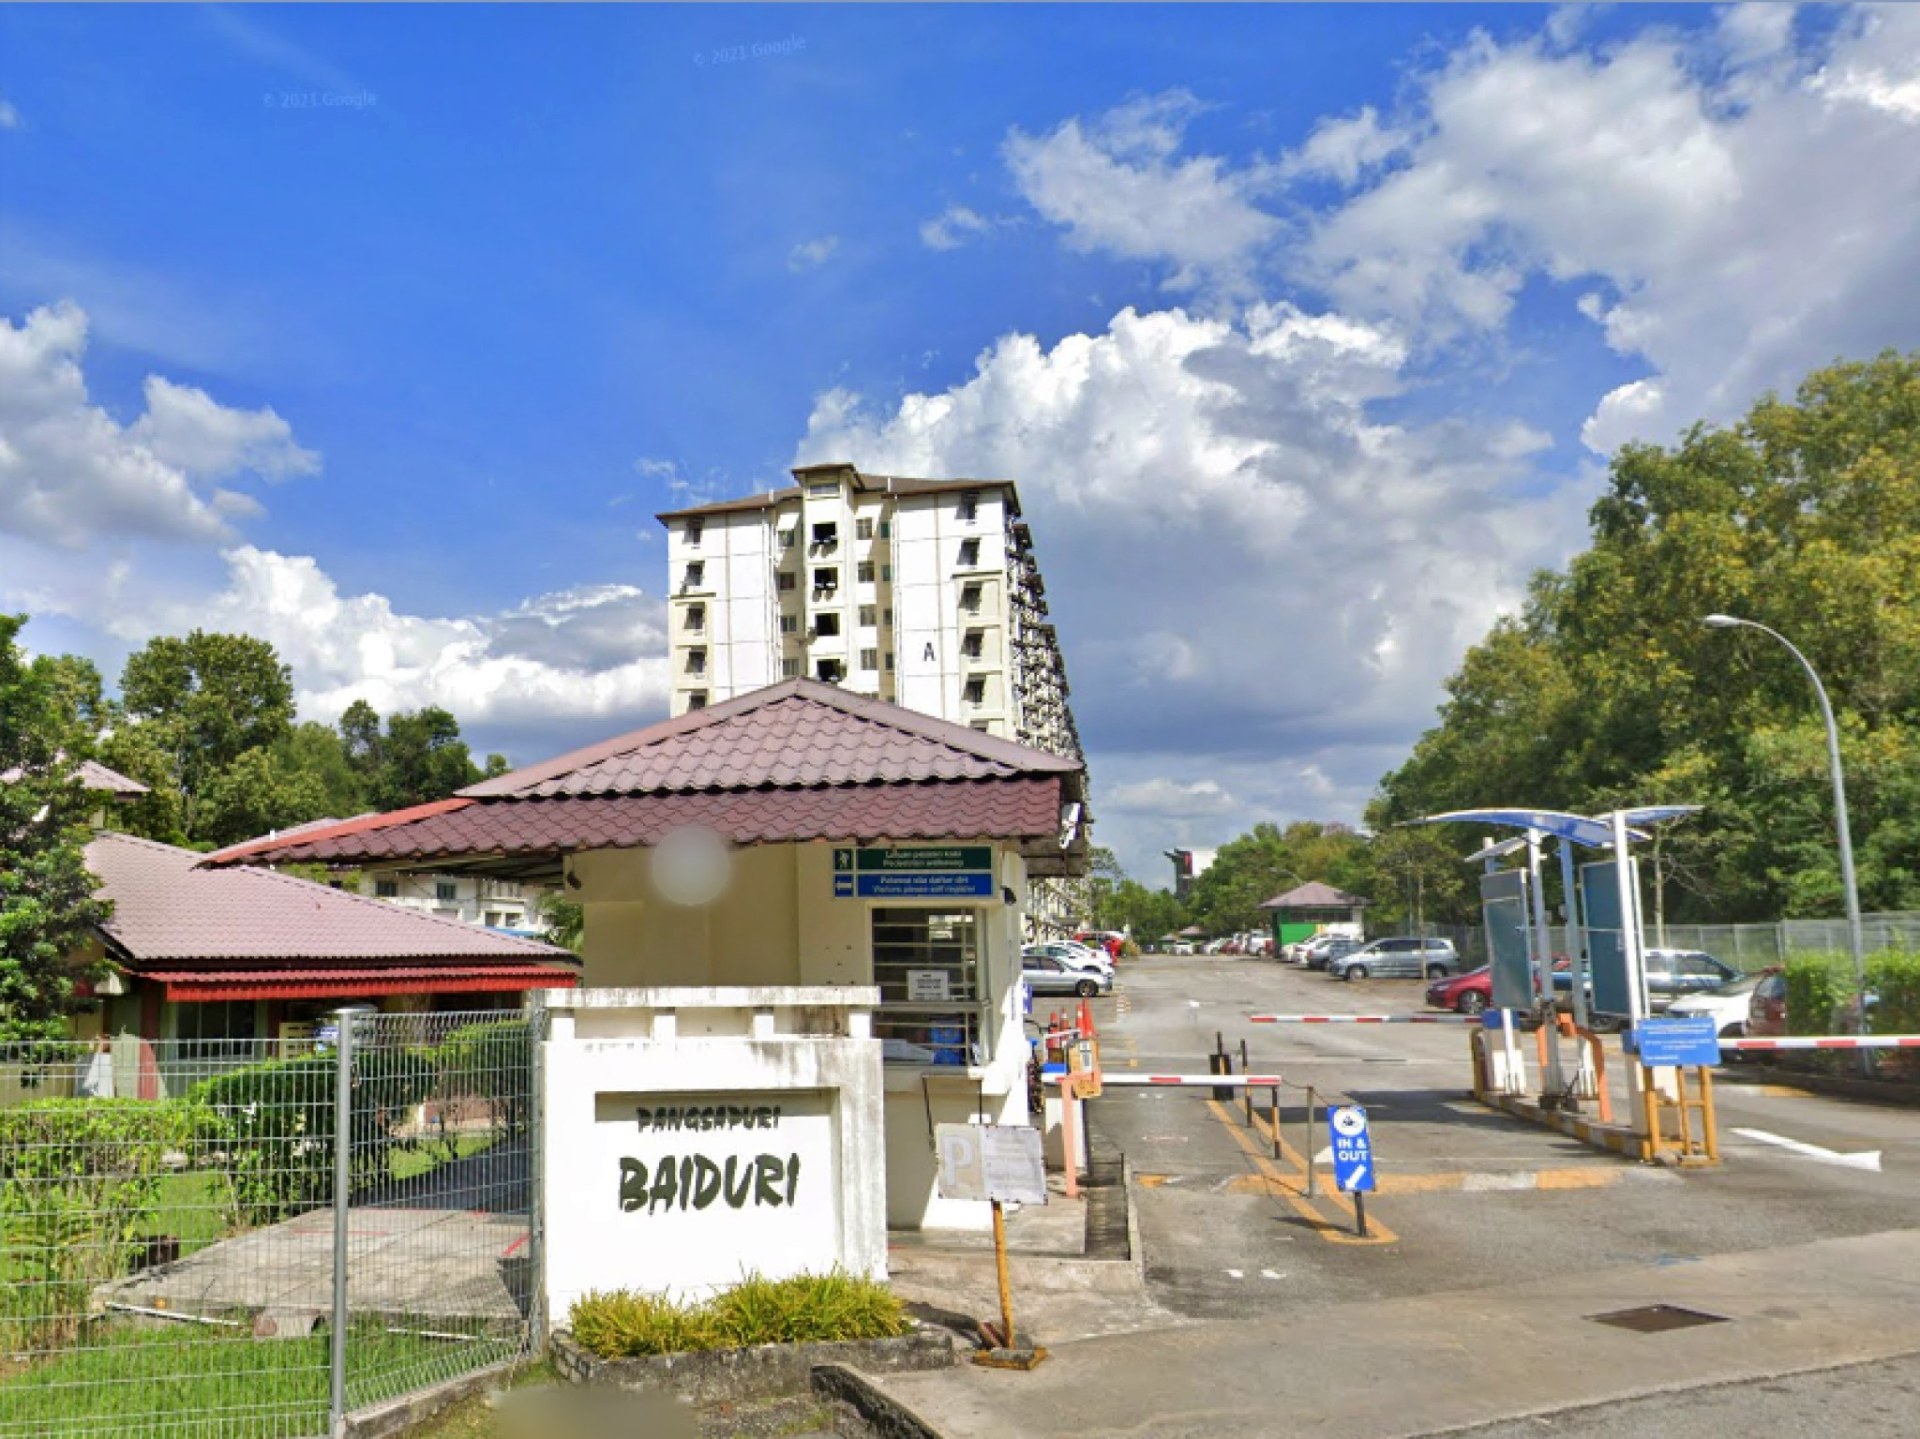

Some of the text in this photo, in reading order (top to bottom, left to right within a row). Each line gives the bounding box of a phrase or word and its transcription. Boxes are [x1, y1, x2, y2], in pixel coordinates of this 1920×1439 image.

[923, 642, 936, 661] A
[636, 1105, 782, 1133] PANGSAPURI
[1337, 1137, 1367, 1149] IN &
[942, 1135, 973, 1186] P
[1339, 1150, 1368, 1162] OUT
[618, 1152, 801, 1216] BAIDURI
